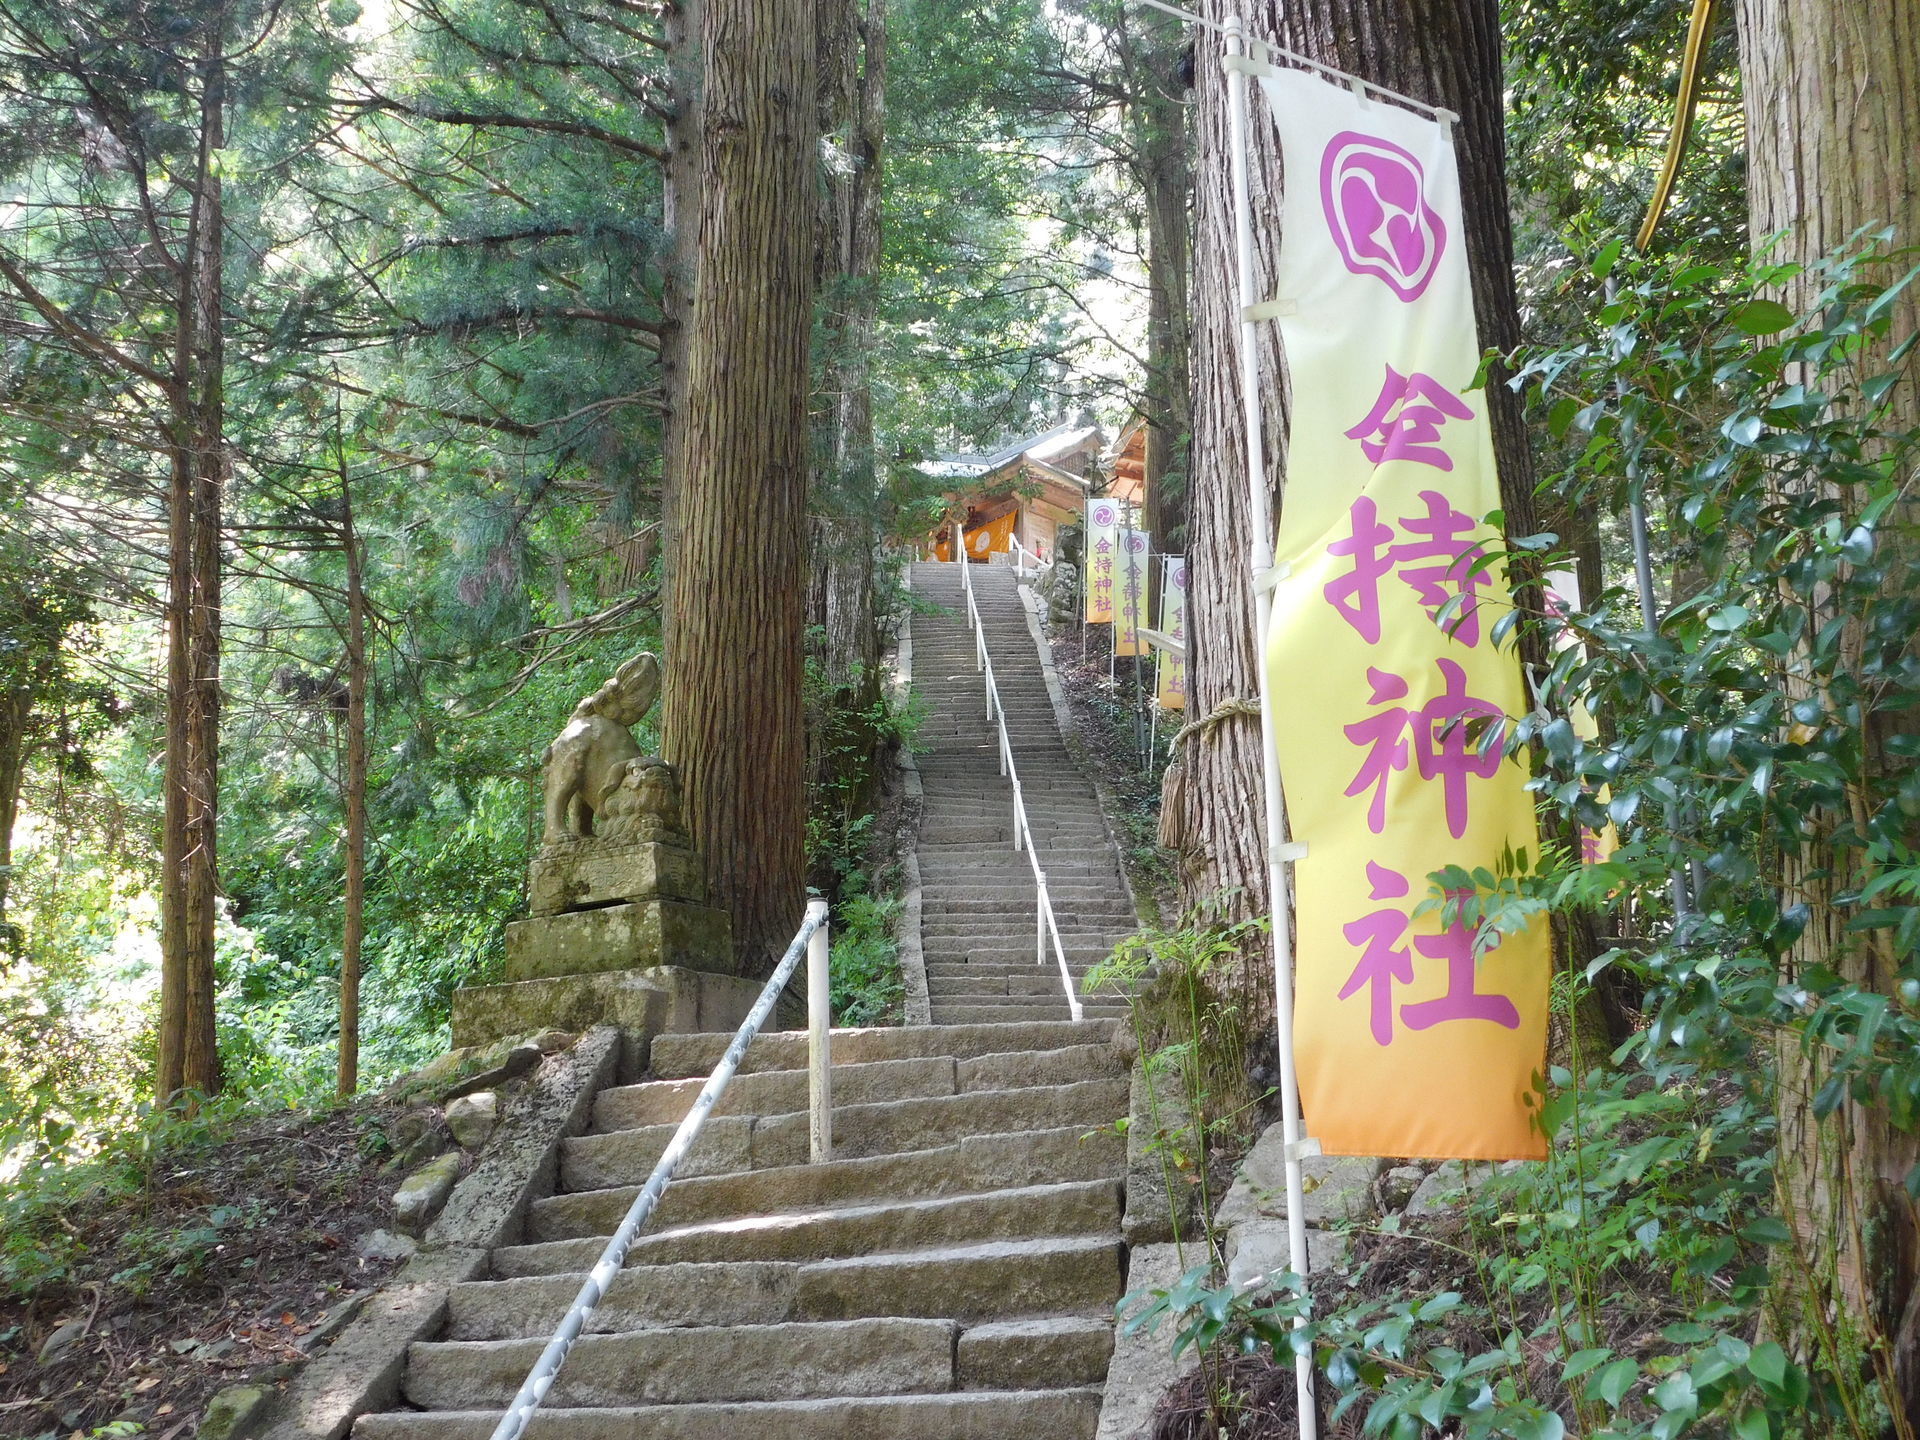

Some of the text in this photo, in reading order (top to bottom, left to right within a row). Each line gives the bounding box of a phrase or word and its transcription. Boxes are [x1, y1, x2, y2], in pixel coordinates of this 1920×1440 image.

[1095, 536, 1113, 613] 金持神社
[1323, 363, 1520, 1046] 金持神社
